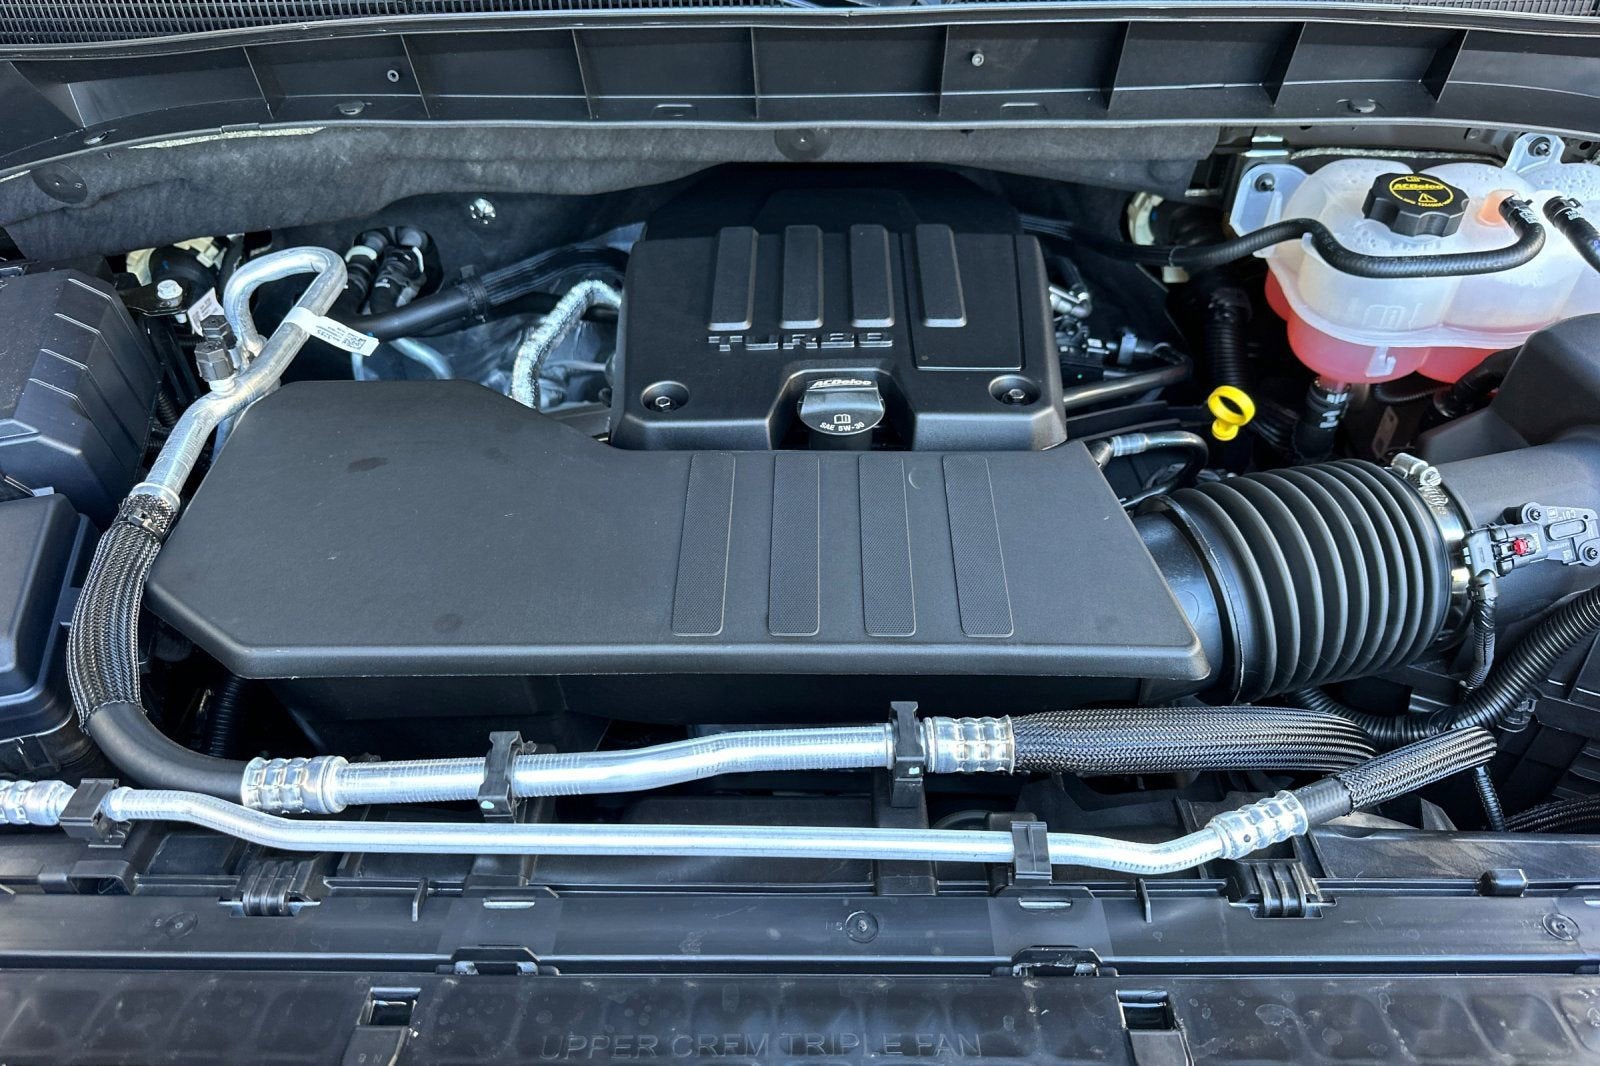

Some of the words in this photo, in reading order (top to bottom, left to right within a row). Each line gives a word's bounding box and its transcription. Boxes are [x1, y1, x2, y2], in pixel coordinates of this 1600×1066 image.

[808, 378, 872, 388] ACDelco
[819, 422, 835, 431] SAE
[838, 422, 865, 432] 5W-30
[538, 1033, 658, 1060] UPPER
[671, 1033, 769, 1058] CRFM
[780, 1031, 903, 1057] TRIPLE
[915, 1033, 982, 1058] FAN
